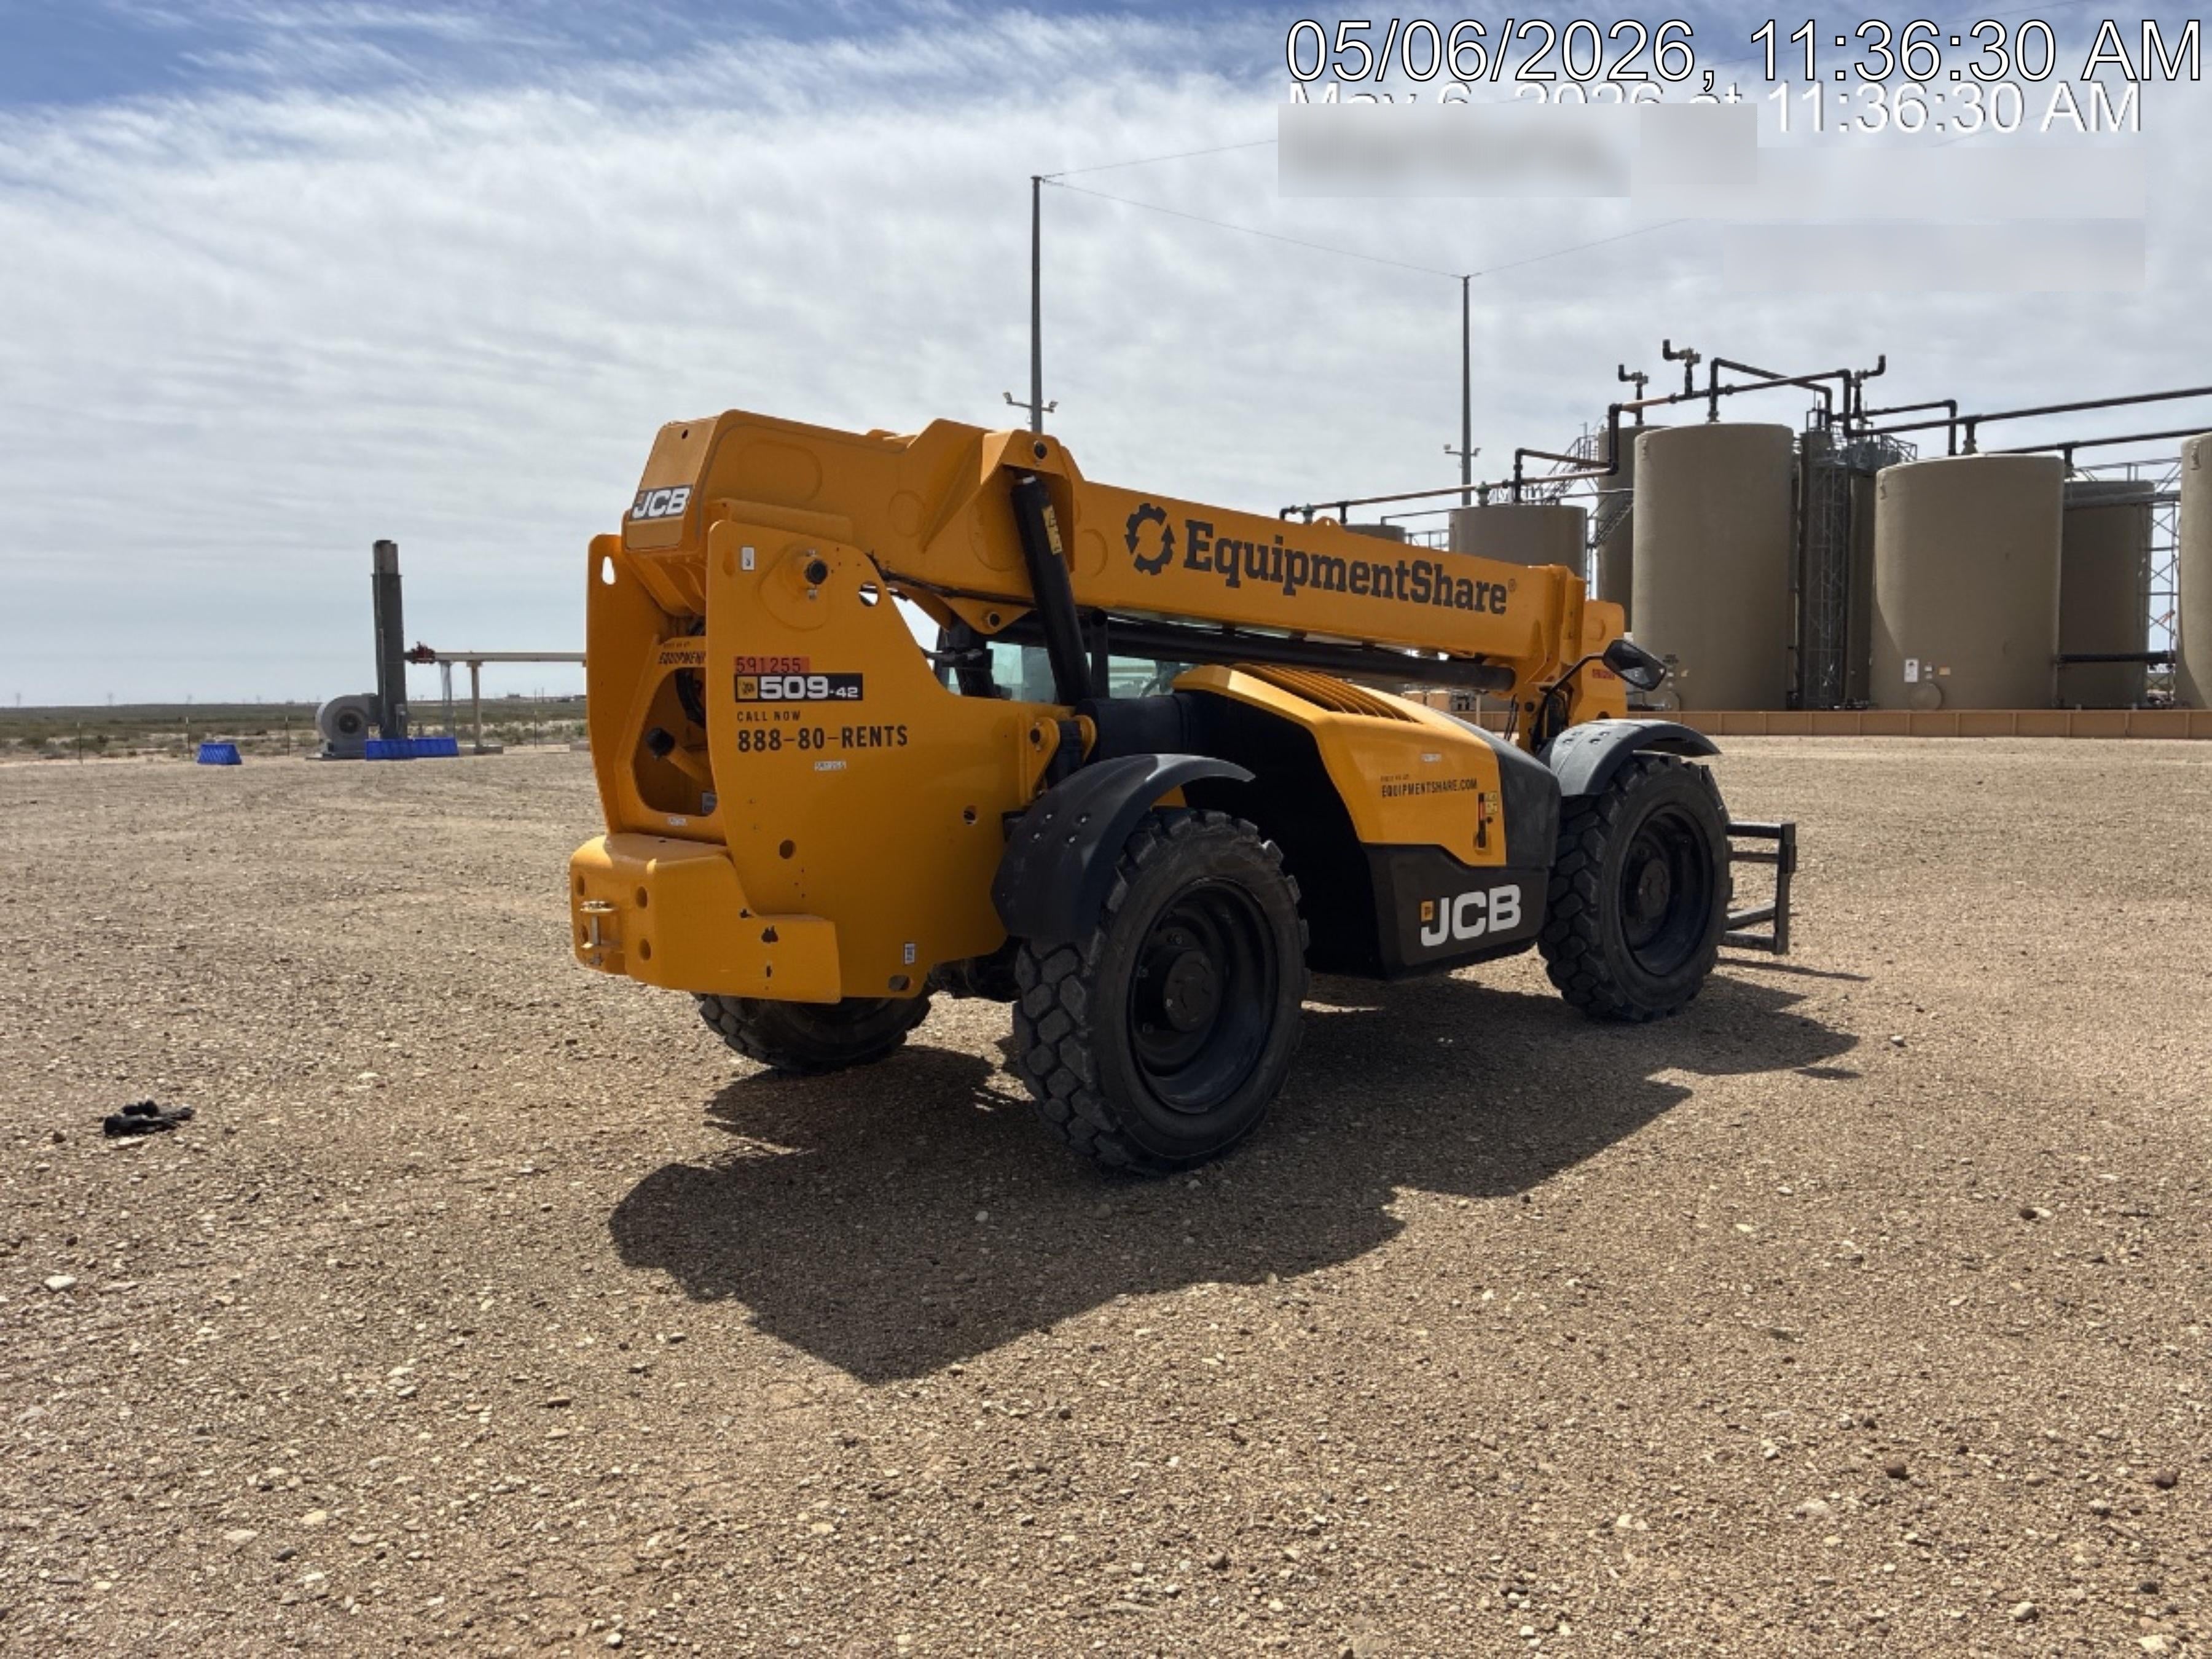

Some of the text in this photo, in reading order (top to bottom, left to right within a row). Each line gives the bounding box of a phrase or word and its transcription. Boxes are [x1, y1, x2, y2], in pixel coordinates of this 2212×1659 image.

[632, 488, 689, 519] JCB
[737, 657, 801, 673] 591255
[760, 676, 859, 699] 509-42
[737, 710, 801, 721] CALL NOW
[738, 724, 908, 752] 888-80-RENTS
[1382, 777, 1478, 798] EQUIPMENTSHARE.COM
[1421, 884, 1521, 947] JCB
